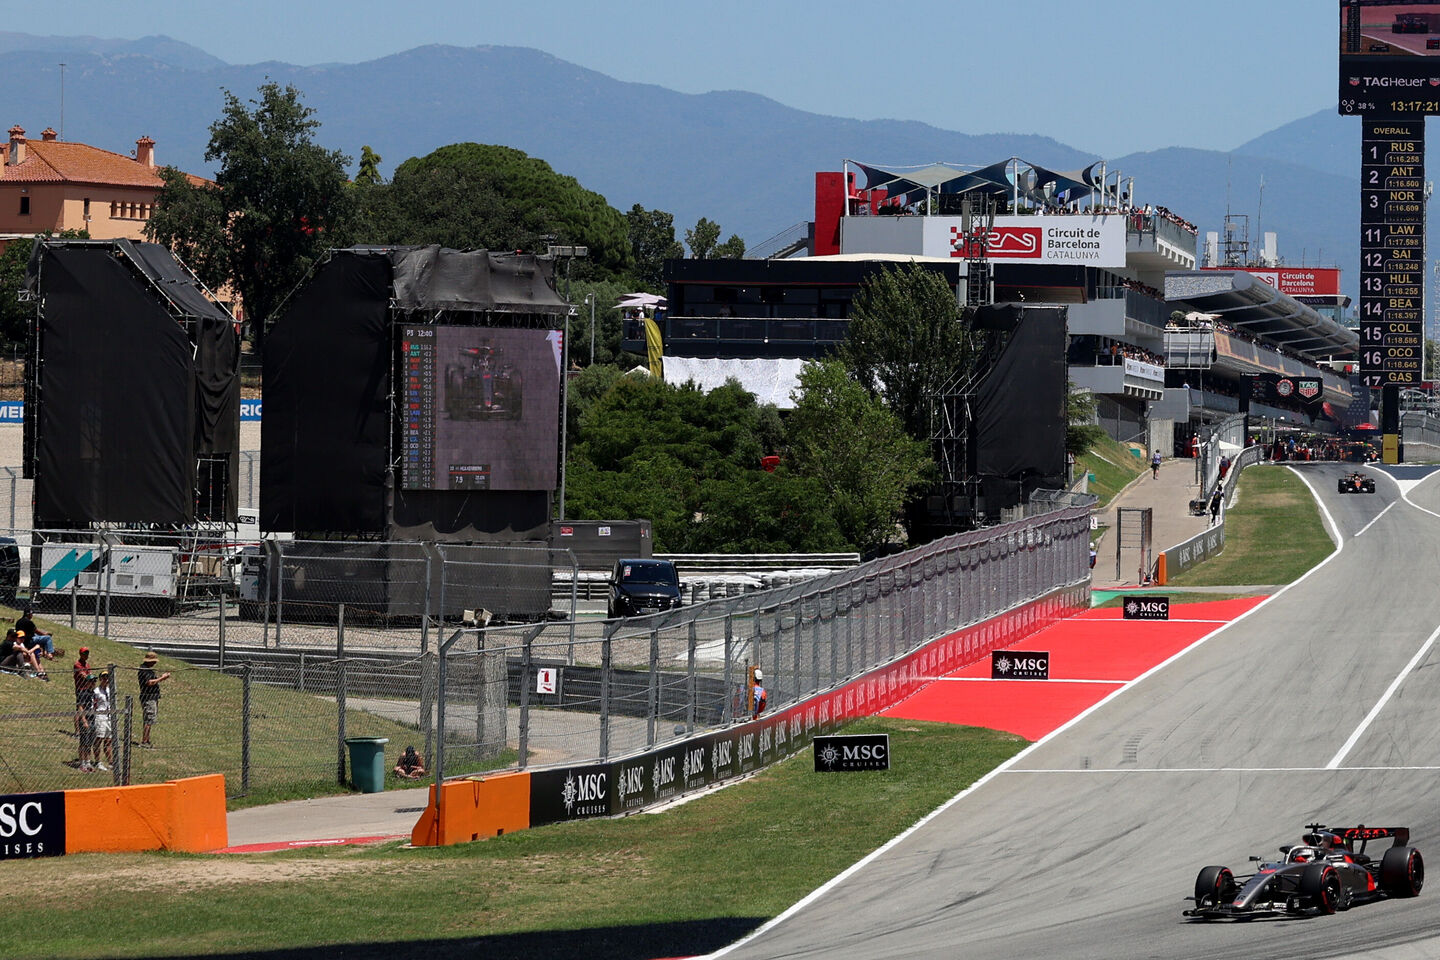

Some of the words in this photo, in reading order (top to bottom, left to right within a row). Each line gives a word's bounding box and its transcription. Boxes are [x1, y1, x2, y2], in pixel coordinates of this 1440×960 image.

[1391, 102, 1439, 111] 13:17:21
[1370, 146, 1377, 159] 1
[1391, 143, 1414, 152] RUS
[1369, 171, 1379, 184] 2
[1391, 167, 1414, 176] ANT
[1369, 195, 1379, 208] 3
[1390, 192, 1415, 200] NOR
[1047, 228, 1085, 238] Circuit
[1087, 228, 1100, 238] de
[1365, 229, 1381, 242] 11
[1390, 226, 1415, 235] LAW
[1047, 239, 1100, 249] Barcelona
[1047, 251, 1100, 259] CATALUNYA
[1364, 253, 1382, 267] 12
[1392, 250, 1411, 259] SAI
[1364, 278, 1382, 291] 13
[1390, 275, 1413, 284] HUL
[1364, 302, 1382, 316] 14
[1389, 299, 1413, 308] BEA
[1363, 327, 1382, 340] 15
[1389, 324, 1413, 333] COL
[1363, 352, 1381, 365] 16
[1388, 348, 1413, 357] OCO
[1363, 376, 1381, 386] 17
[1388, 373, 1413, 382] GAS
[1140, 602, 1167, 612] MSC
[1013, 658, 1047, 671] MSC
[718, 740, 732, 767] MSC
[843, 745, 885, 760] MSC
[690, 748, 705, 774] MSC
[660, 757, 676, 785] MSC
[578, 773, 606, 801] MSC
[626, 766, 644, 794] MSC
[577, 805, 606, 815] CRUISES
